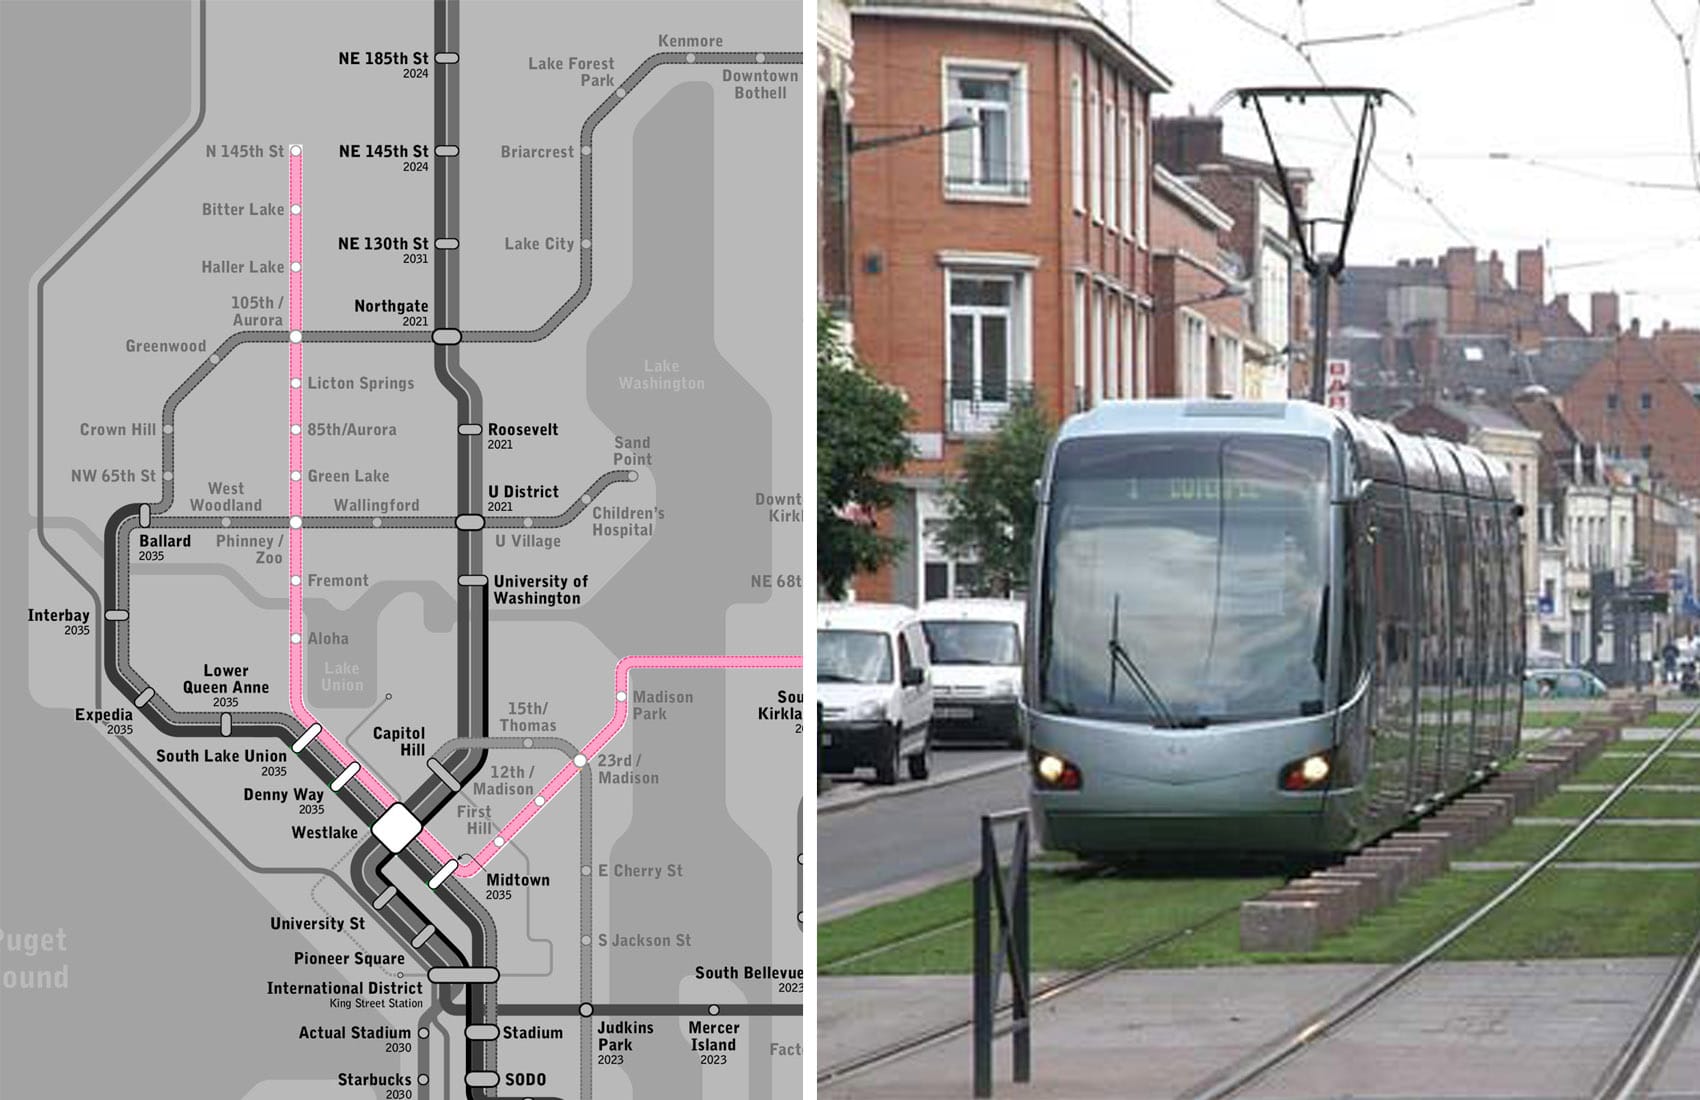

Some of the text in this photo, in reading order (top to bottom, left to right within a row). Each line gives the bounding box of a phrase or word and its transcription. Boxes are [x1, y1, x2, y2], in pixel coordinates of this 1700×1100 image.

[658, 34, 723, 47] Kenmore
[339, 51, 429, 65] NE 185th St
[529, 56, 615, 70] Lake Forest
[403, 68, 429, 79] 2024
[581, 73, 614, 87] Park
[723, 69, 798, 82] Downtown
[735, 86, 786, 99] Bothell
[206, 144, 284, 158] N 145th St
[339, 144, 429, 158] NE 145th St
[501, 145, 574, 158] Briarcrest
[403, 161, 429, 172] 2024
[202, 202, 284, 216] Bitter Lake
[338, 236, 429, 251] NE 130th St
[505, 237, 574, 253] Lake City
[403, 253, 428, 264] 2031
[202, 260, 285, 274] Haller Lake
[231, 296, 274, 309] 105th
[355, 299, 429, 316] Northgate
[233, 313, 283, 326] Aurora
[402, 316, 428, 327] 2021
[126, 339, 206, 353] Greenwood
[644, 359, 680, 373] Lake
[308, 376, 414, 392] Licton Springs
[618, 375, 705, 393] Washington
[80, 422, 156, 436] Crown Hill
[307, 422, 397, 436] 85th/Aurora
[488, 422, 559, 436] Roosevelt
[487, 439, 513, 450] 2021
[614, 435, 651, 449] Sand
[613, 452, 652, 466] Point
[71, 469, 156, 483] NW 65th St
[308, 469, 390, 482] Green Lake
[208, 481, 244, 495] West
[488, 484, 559, 499] U District
[190, 498, 262, 512] Woodland
[333, 498, 420, 515] Wallingford
[487, 501, 513, 512] 2021
[593, 523, 653, 539] Hospital
[139, 534, 191, 548] Ballard
[216, 534, 274, 550] Phinney
[495, 534, 561, 550] U Village
[139, 550, 165, 561] 2035
[256, 551, 282, 564] Zoo
[308, 573, 369, 587] Fremont
[494, 574, 589, 591] University of
[751, 574, 772, 588] NE
[493, 590, 581, 607] Washington
[28, 608, 90, 625] Interbay
[64, 624, 90, 636] 2035
[307, 631, 349, 645] Aloha
[204, 663, 249, 677] Lower
[324, 661, 360, 675] Lake
[183, 680, 269, 694] Queen Anne
[321, 677, 364, 692] Union
[213, 697, 239, 708] 2035
[633, 690, 693, 704] Madison
[777, 690, 803, 704] Sou
[509, 702, 548, 715] 15th/
[633, 706, 667, 720] Park
[75, 707, 133, 725] Expedia
[107, 724, 133, 735] 2035
[499, 718, 557, 732] Thomas
[373, 726, 425, 744] Capitol
[156, 749, 287, 763] South Lake Union
[400, 743, 425, 756] Hill
[598, 754, 632, 767] 23rd
[261, 766, 287, 777] 2035
[491, 765, 525, 779] 12th
[599, 771, 659, 784] Madison
[244, 787, 324, 804] Denny Way
[473, 782, 534, 795] Madison
[299, 804, 325, 815] 2035
[457, 805, 491, 818] First
[291, 825, 358, 839] Westlake
[467, 821, 491, 835] Hill
[598, 863, 683, 880] E Cherry St
[486, 873, 550, 887] Midtown
[486, 889, 512, 900] 2035
[270, 916, 365, 933] University St
[598, 933, 692, 947] S Jackson St
[294, 951, 405, 968] Pioneer Square
[695, 965, 803, 980] South Bellevue
[267, 981, 423, 995] International District
[778, 982, 803, 993] 2023
[329, 998, 423, 1010] King Street Station
[298, 1025, 411, 1040] Actual Stadium
[503, 1025, 563, 1040] Stadium
[597, 1020, 654, 1034] Judkins
[689, 1020, 740, 1034] Mercer
[385, 1042, 412, 1053] 2030
[598, 1038, 633, 1052] Park
[691, 1038, 736, 1051] Island
[598, 1054, 624, 1065] 2023
[700, 1054, 727, 1065] 2023
[338, 1072, 412, 1086] Starbucks
[505, 1072, 546, 1086] SODO
[386, 1089, 412, 1100] 2030
